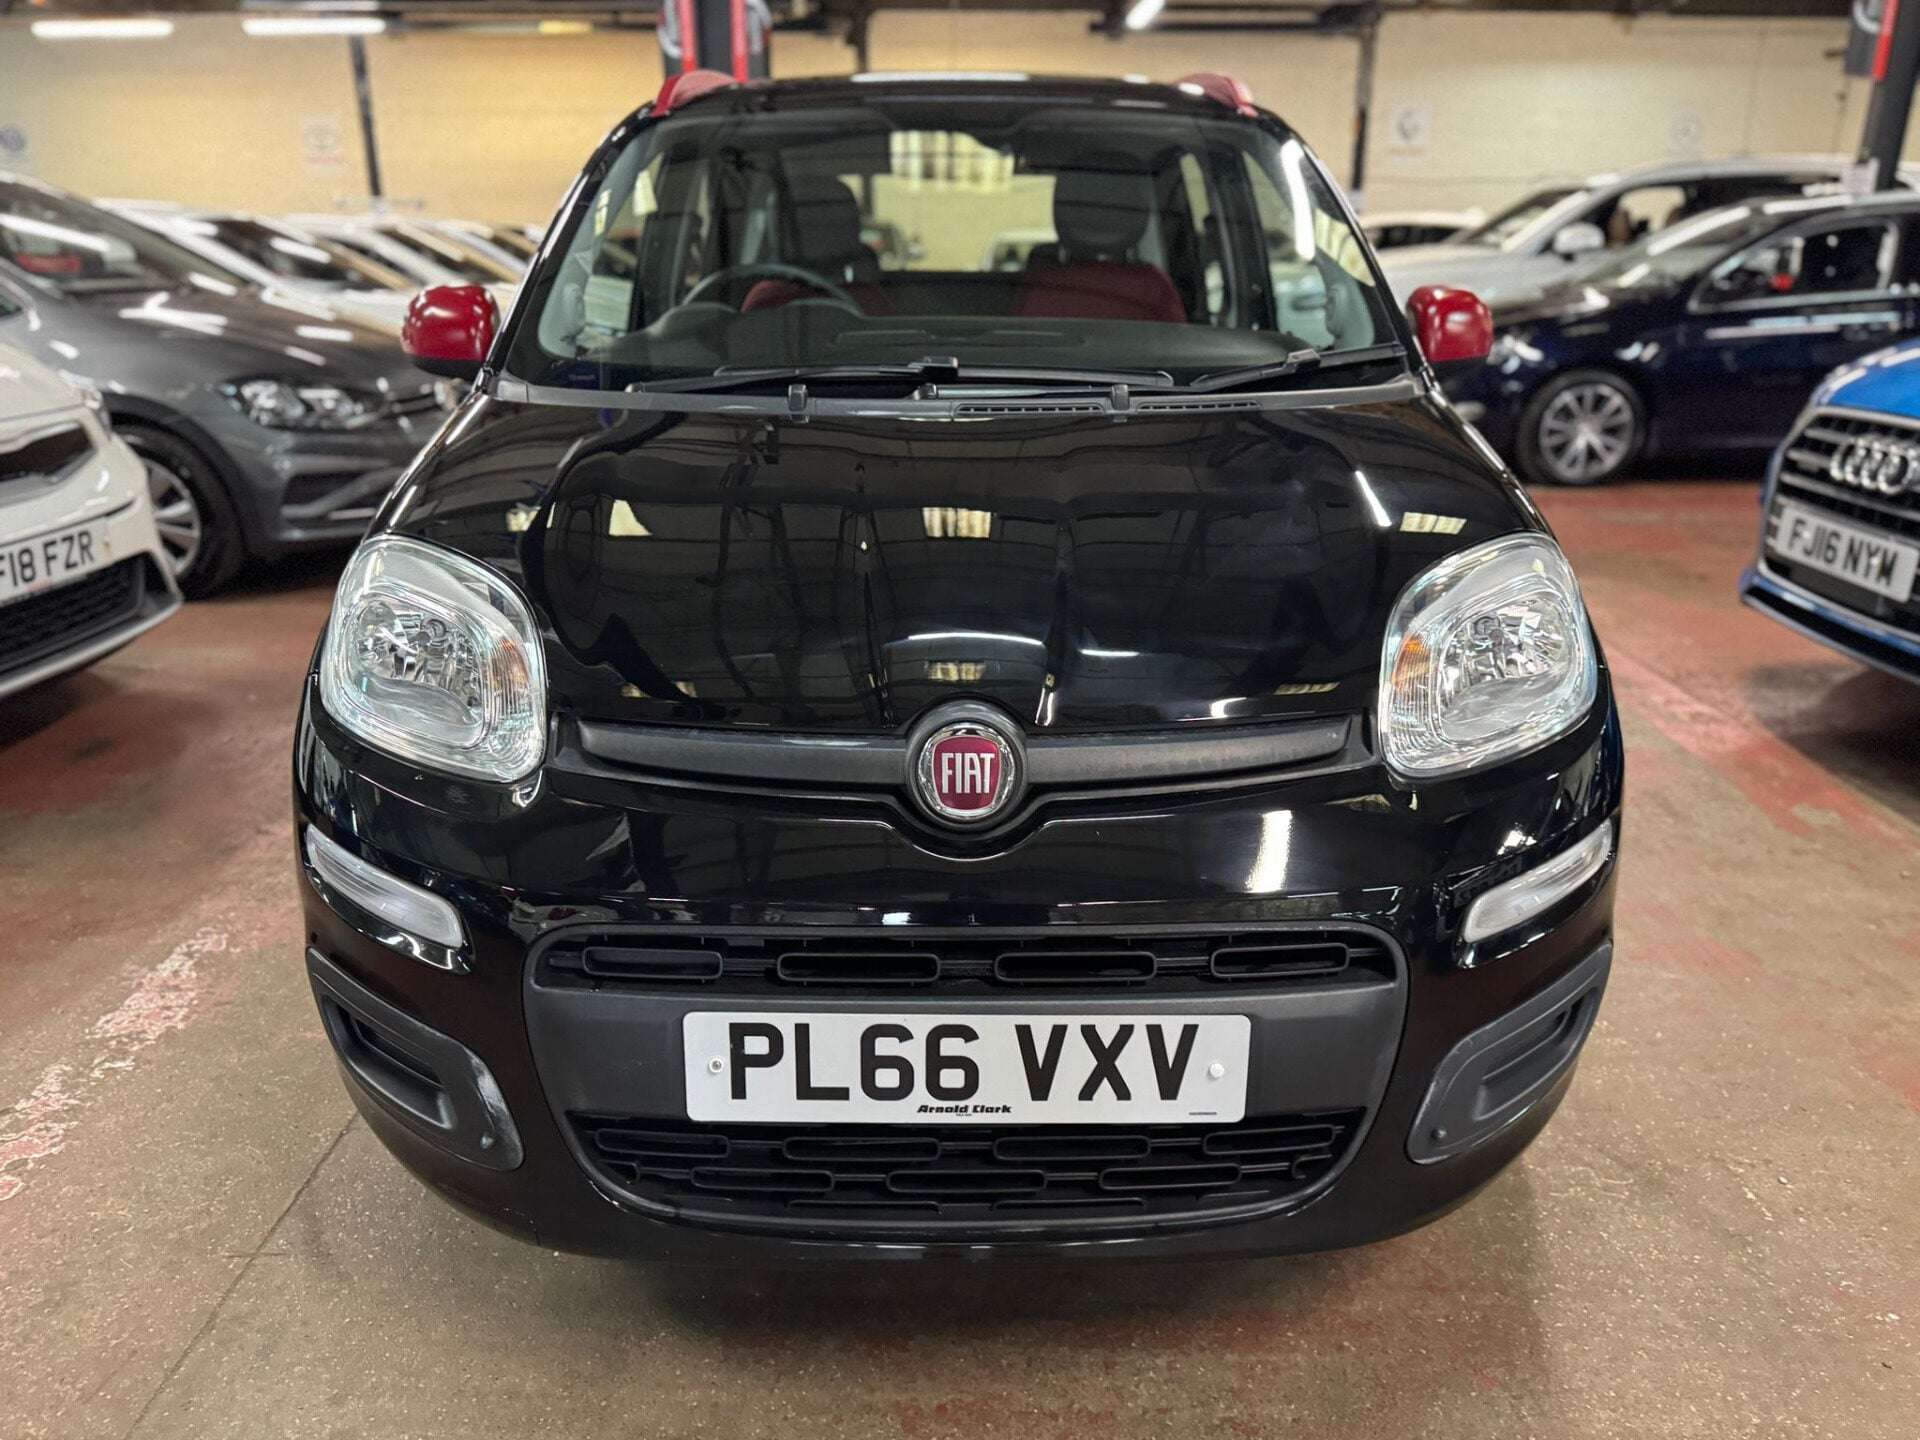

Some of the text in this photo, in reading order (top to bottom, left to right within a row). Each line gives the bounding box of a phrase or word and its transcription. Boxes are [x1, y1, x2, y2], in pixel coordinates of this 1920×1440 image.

[43, 531, 94, 576] FZR
[1789, 518, 1898, 587] FJ16 NYM
[941, 752, 995, 794] FIAT
[730, 1023, 1199, 1101] PL66 VXV
[917, 1104, 1012, 1113] Arnold Clark
